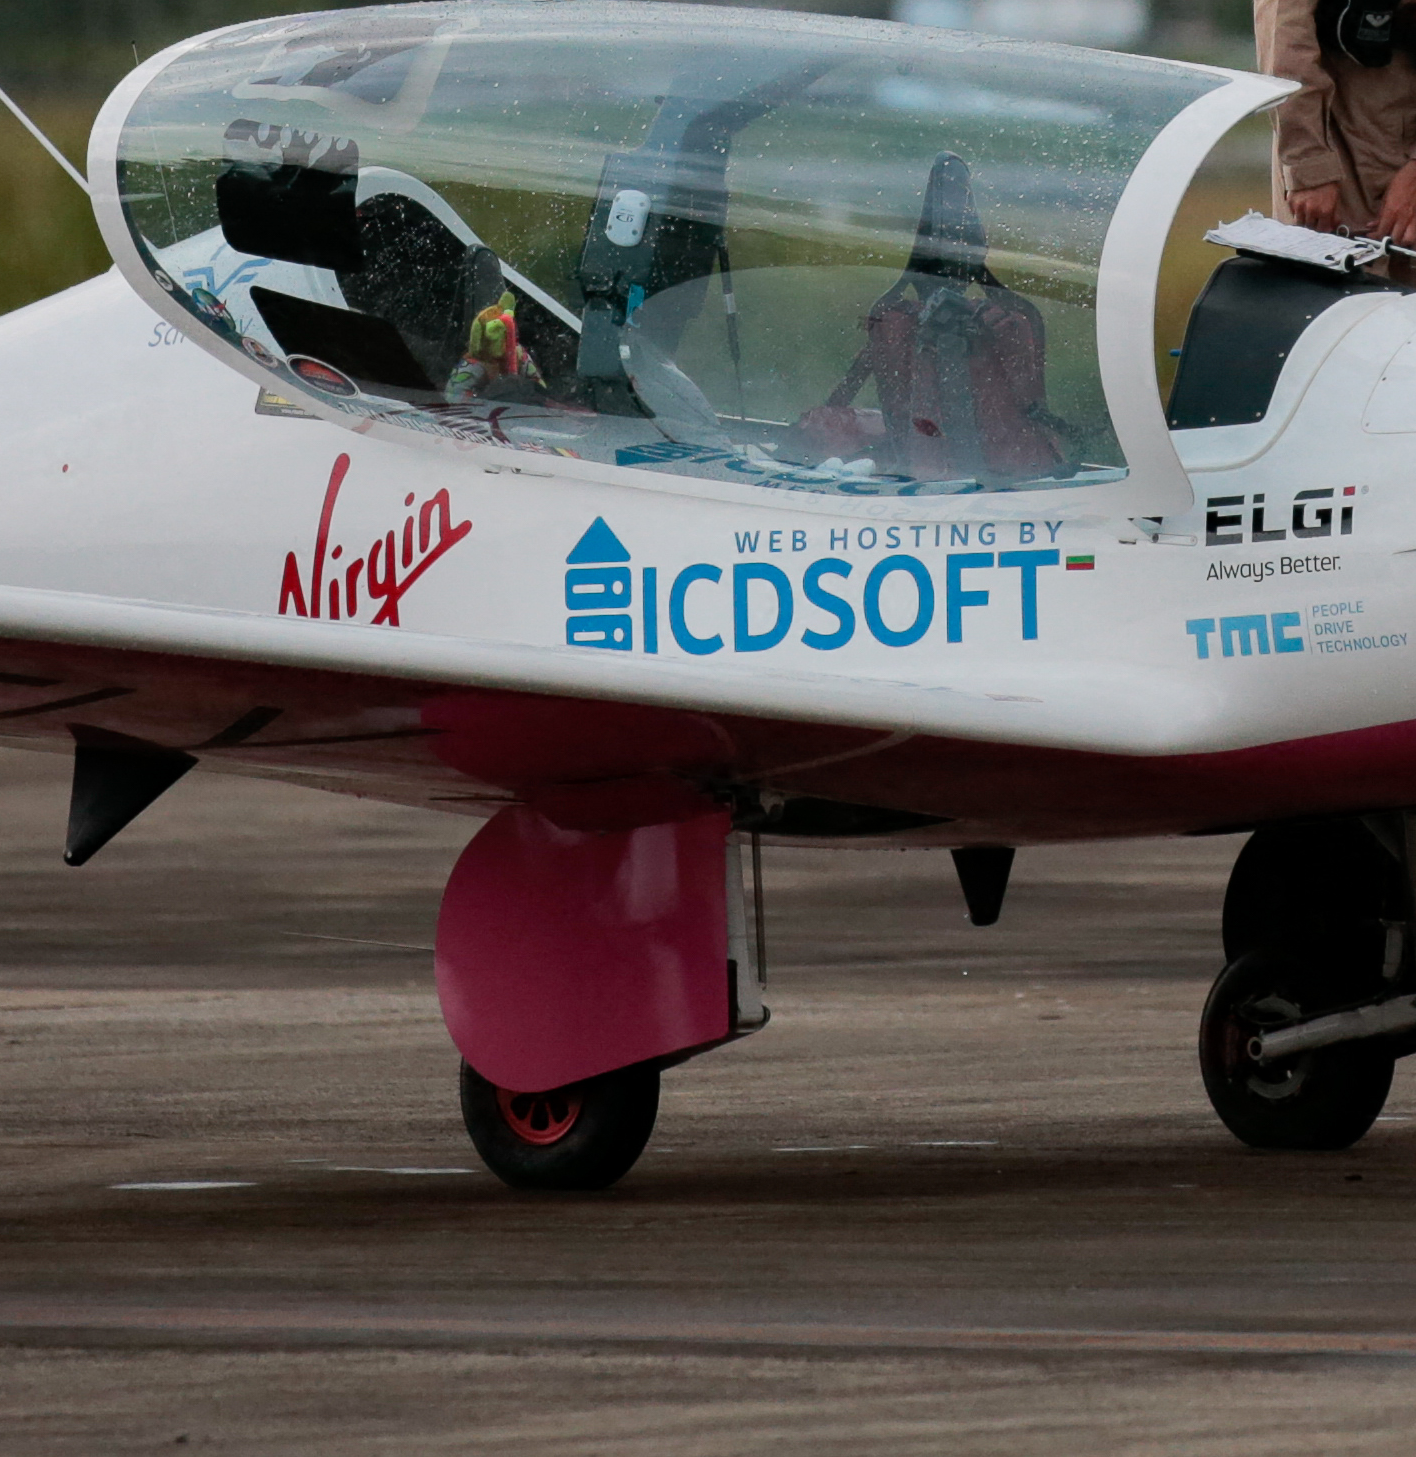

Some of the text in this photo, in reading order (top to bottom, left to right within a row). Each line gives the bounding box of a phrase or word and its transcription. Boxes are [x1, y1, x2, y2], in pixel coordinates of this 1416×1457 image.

[279, 452, 473, 627] Virgin
[735, 521, 1063, 553] WEB HOSTING BY
[1206, 555, 1341, 583] Always Better.
[642, 548, 1060, 656] ICDSOFT
[1312, 601, 1364, 618] PEOPLE
[1314, 620, 1354, 636] DRIVE
[1317, 633, 1408, 654] TECHNOLOGY
